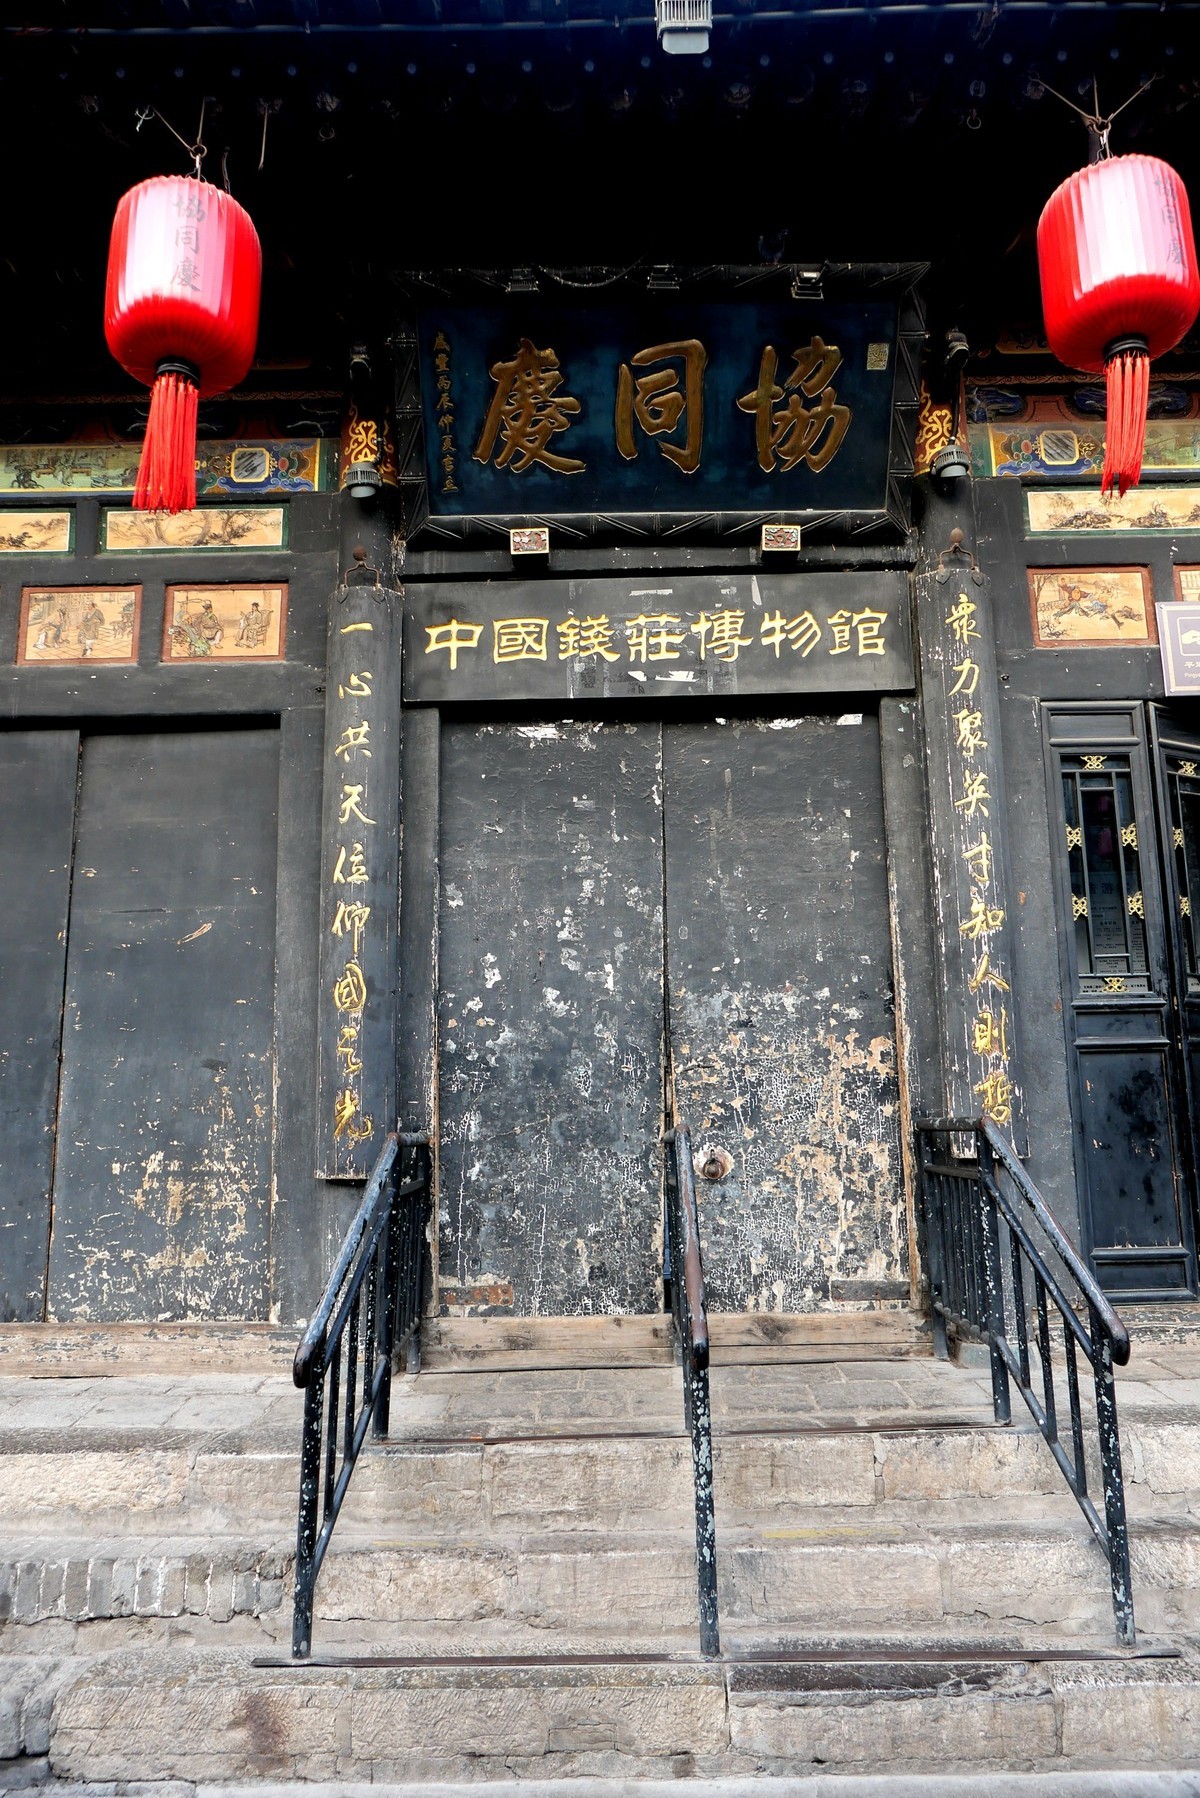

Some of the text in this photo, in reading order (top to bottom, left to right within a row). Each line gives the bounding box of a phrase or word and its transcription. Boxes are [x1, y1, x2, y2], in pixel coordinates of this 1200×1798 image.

[424, 606, 888, 671] 中國錢莊博物館
